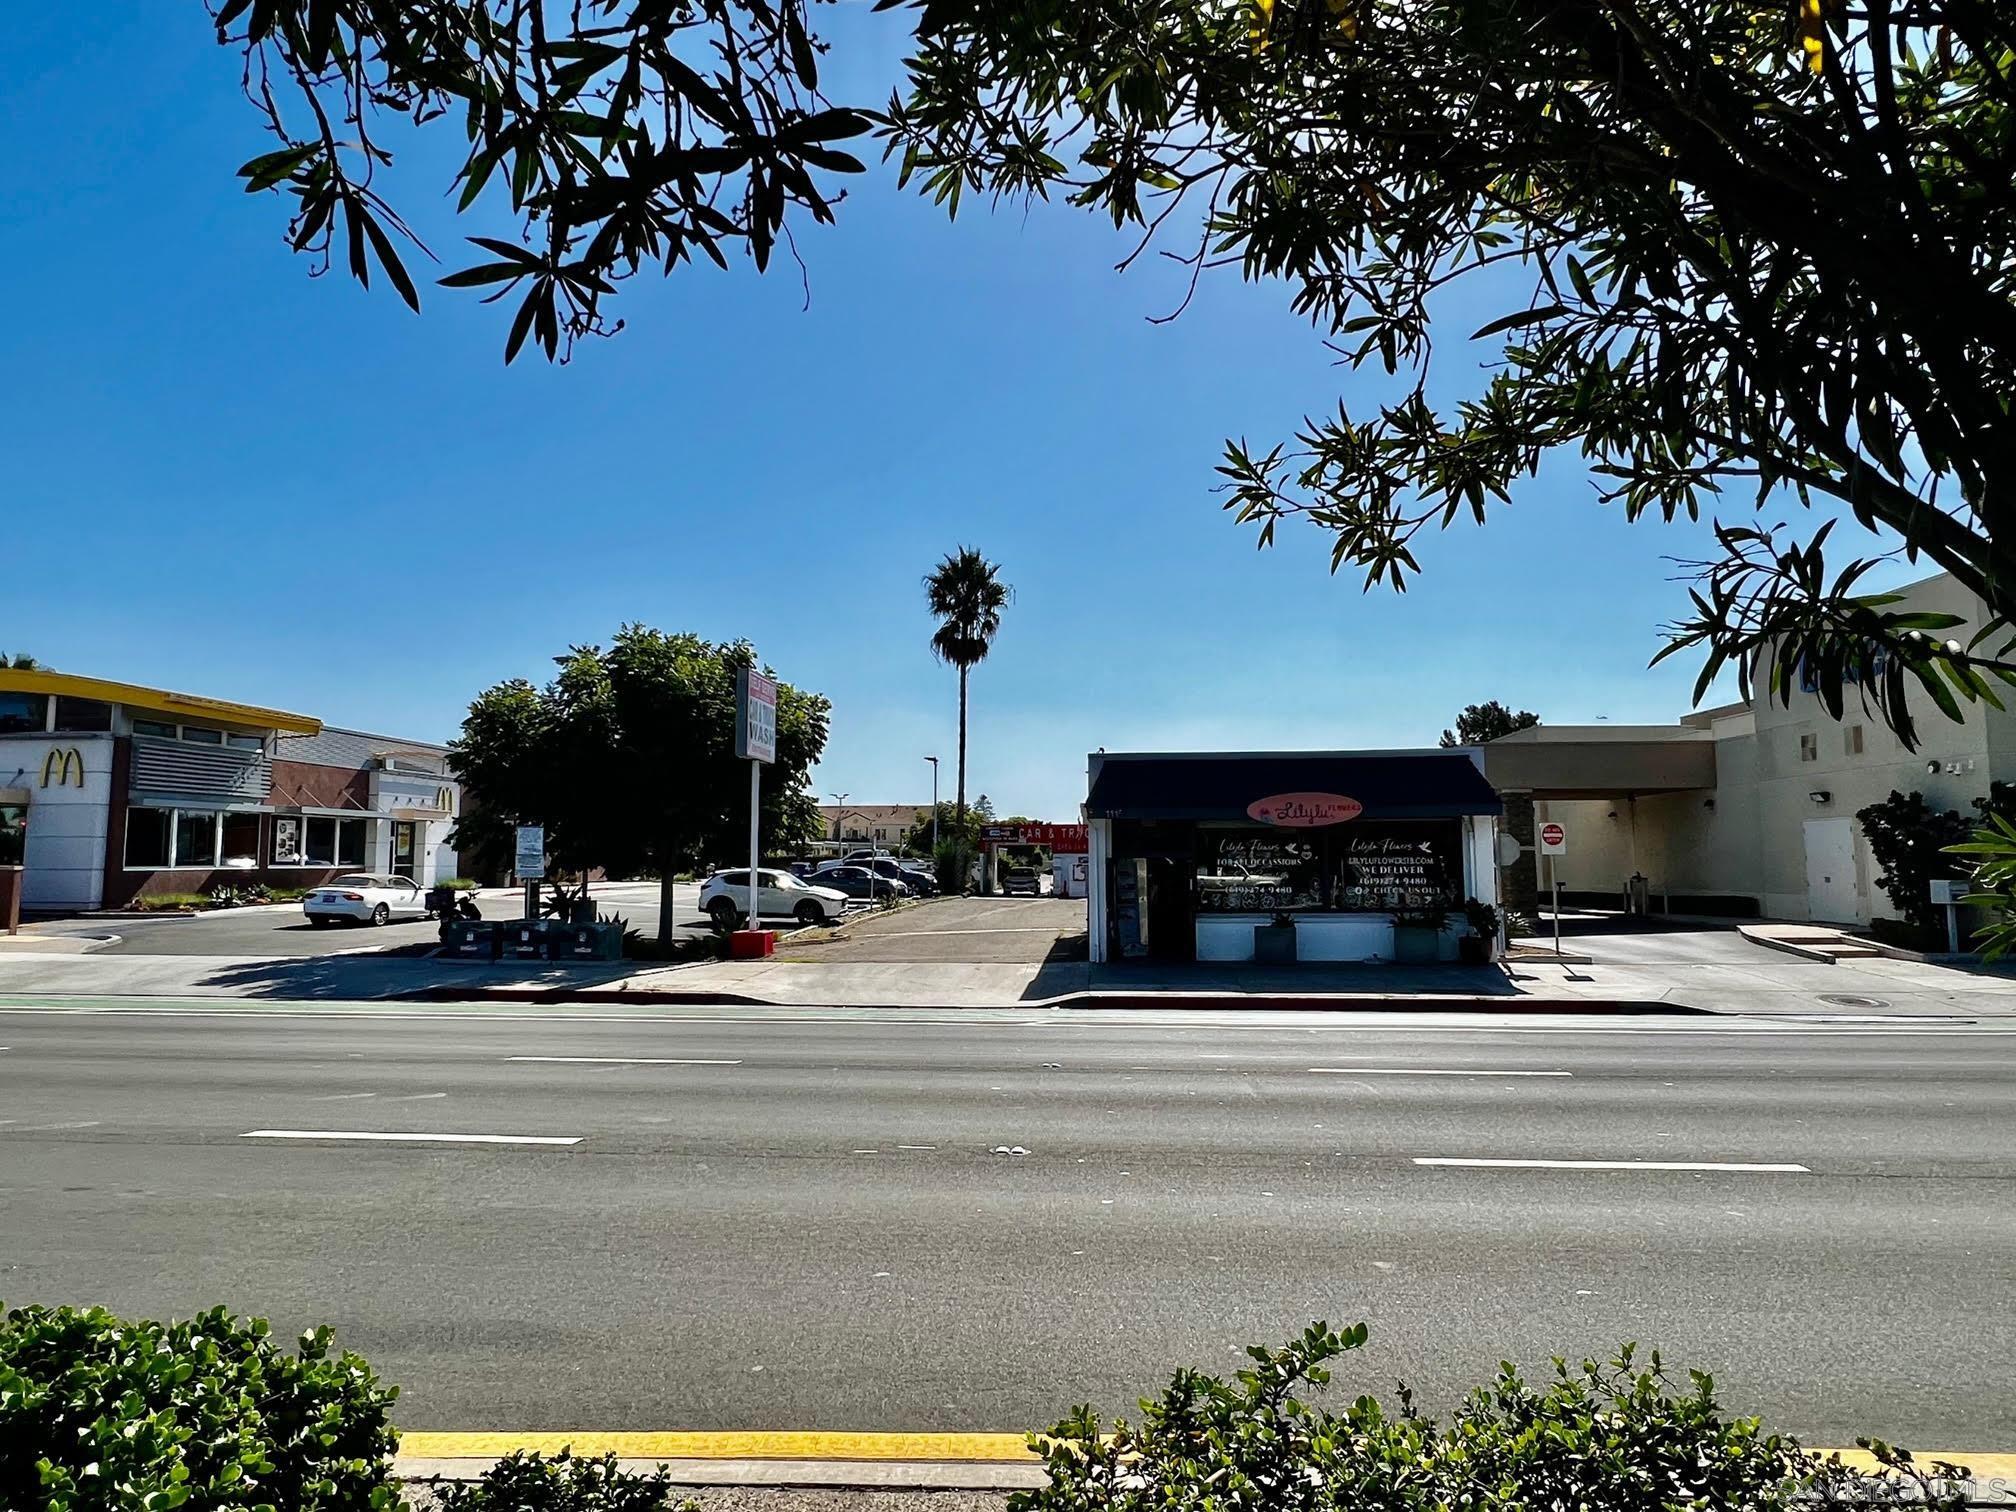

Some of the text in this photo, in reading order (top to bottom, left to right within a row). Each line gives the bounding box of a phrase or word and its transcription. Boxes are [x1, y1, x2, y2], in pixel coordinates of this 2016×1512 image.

[750, 721, 775, 748] WASH
[1018, 828, 1041, 839] CAR
[1048, 828, 1055, 839] &
[1362, 866, 1424, 874] WE DELIVER
